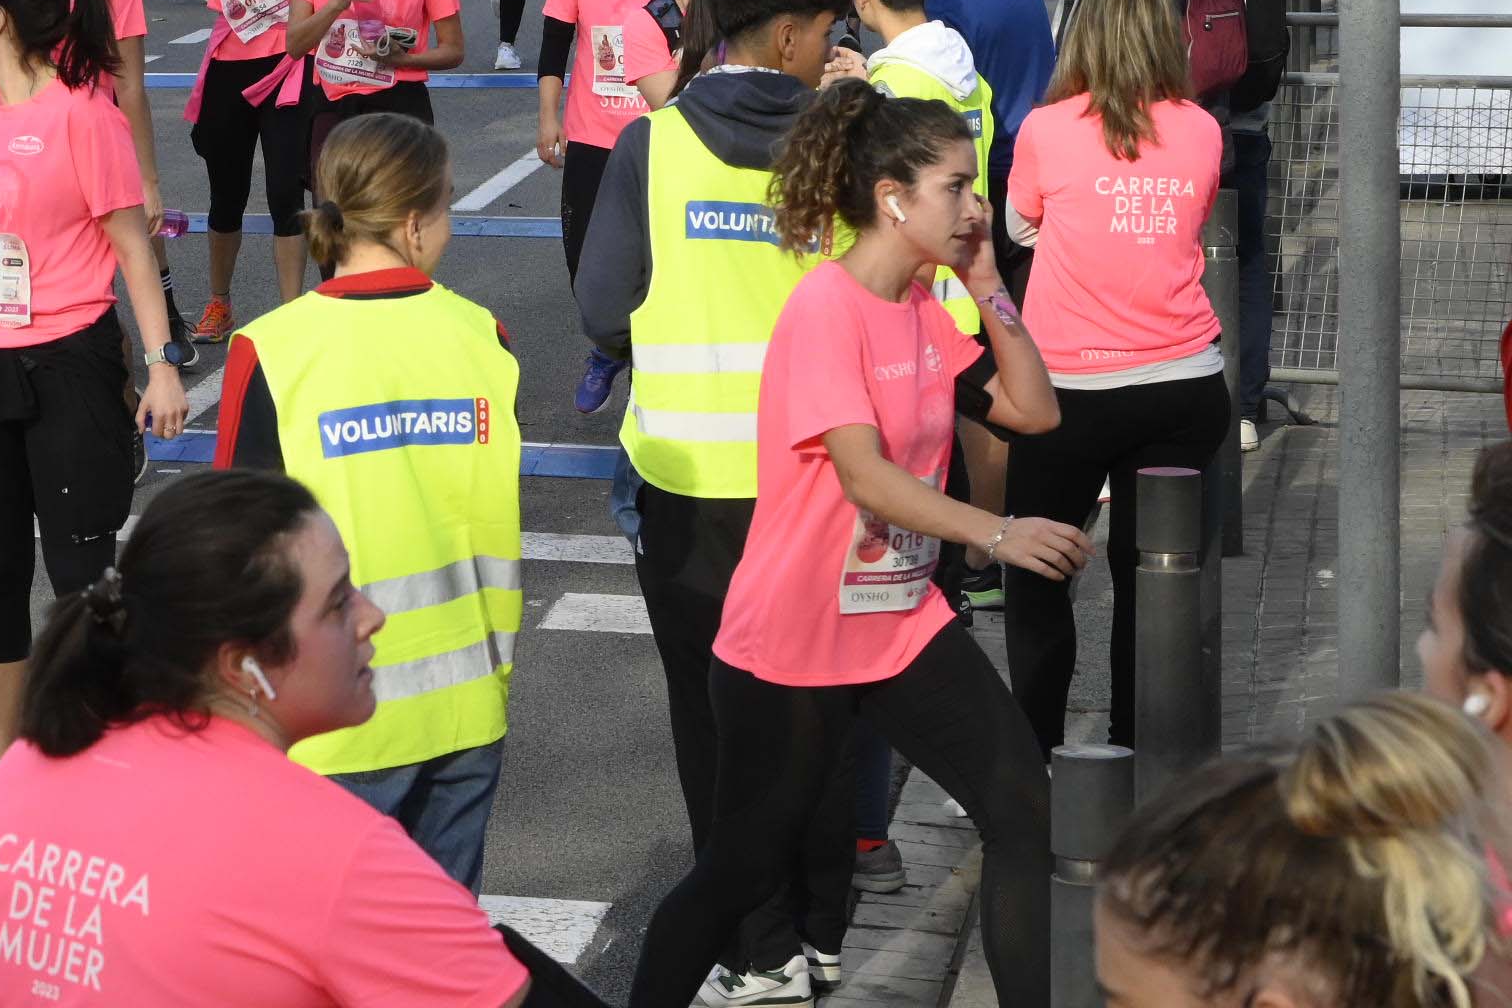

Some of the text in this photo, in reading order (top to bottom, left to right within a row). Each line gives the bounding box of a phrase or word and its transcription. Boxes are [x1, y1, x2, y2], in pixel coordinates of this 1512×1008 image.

[346, 47, 368, 59] 01
[1095, 176, 1196, 198] CARRERA
[1114, 196, 1176, 215] DE LA
[1110, 215, 1178, 234] MUJER
[323, 411, 473, 446] VOLUNTARIS
[857, 574, 892, 582] CARRERA
[850, 591, 890, 603] OYSHO
[9, 881, 104, 945] DE LA
[31, 978, 60, 1001] 2023
